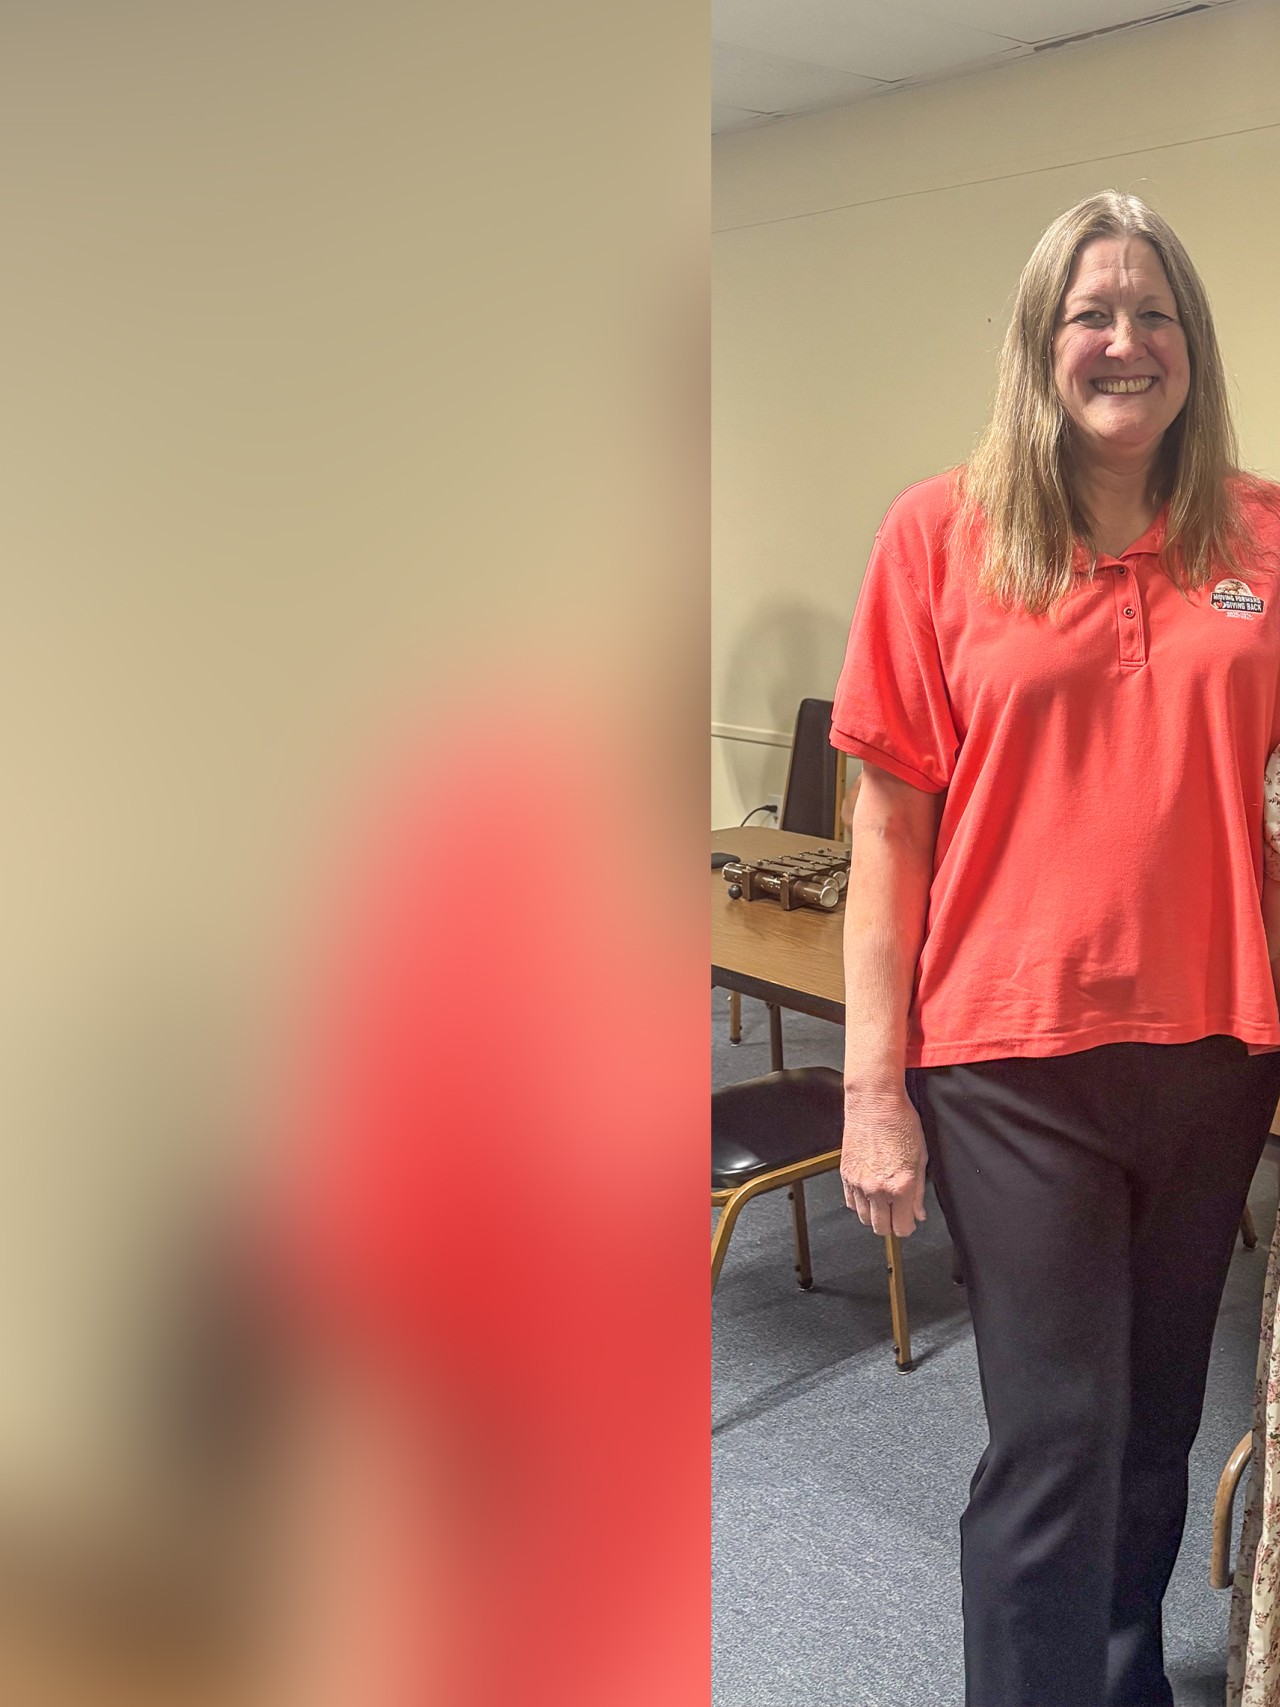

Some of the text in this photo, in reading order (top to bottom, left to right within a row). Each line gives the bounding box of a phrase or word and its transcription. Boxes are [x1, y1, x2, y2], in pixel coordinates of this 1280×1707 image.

[1213, 593, 1262, 604] MOVING FORWARD
[1226, 601, 1262, 612] GIVING BACK
